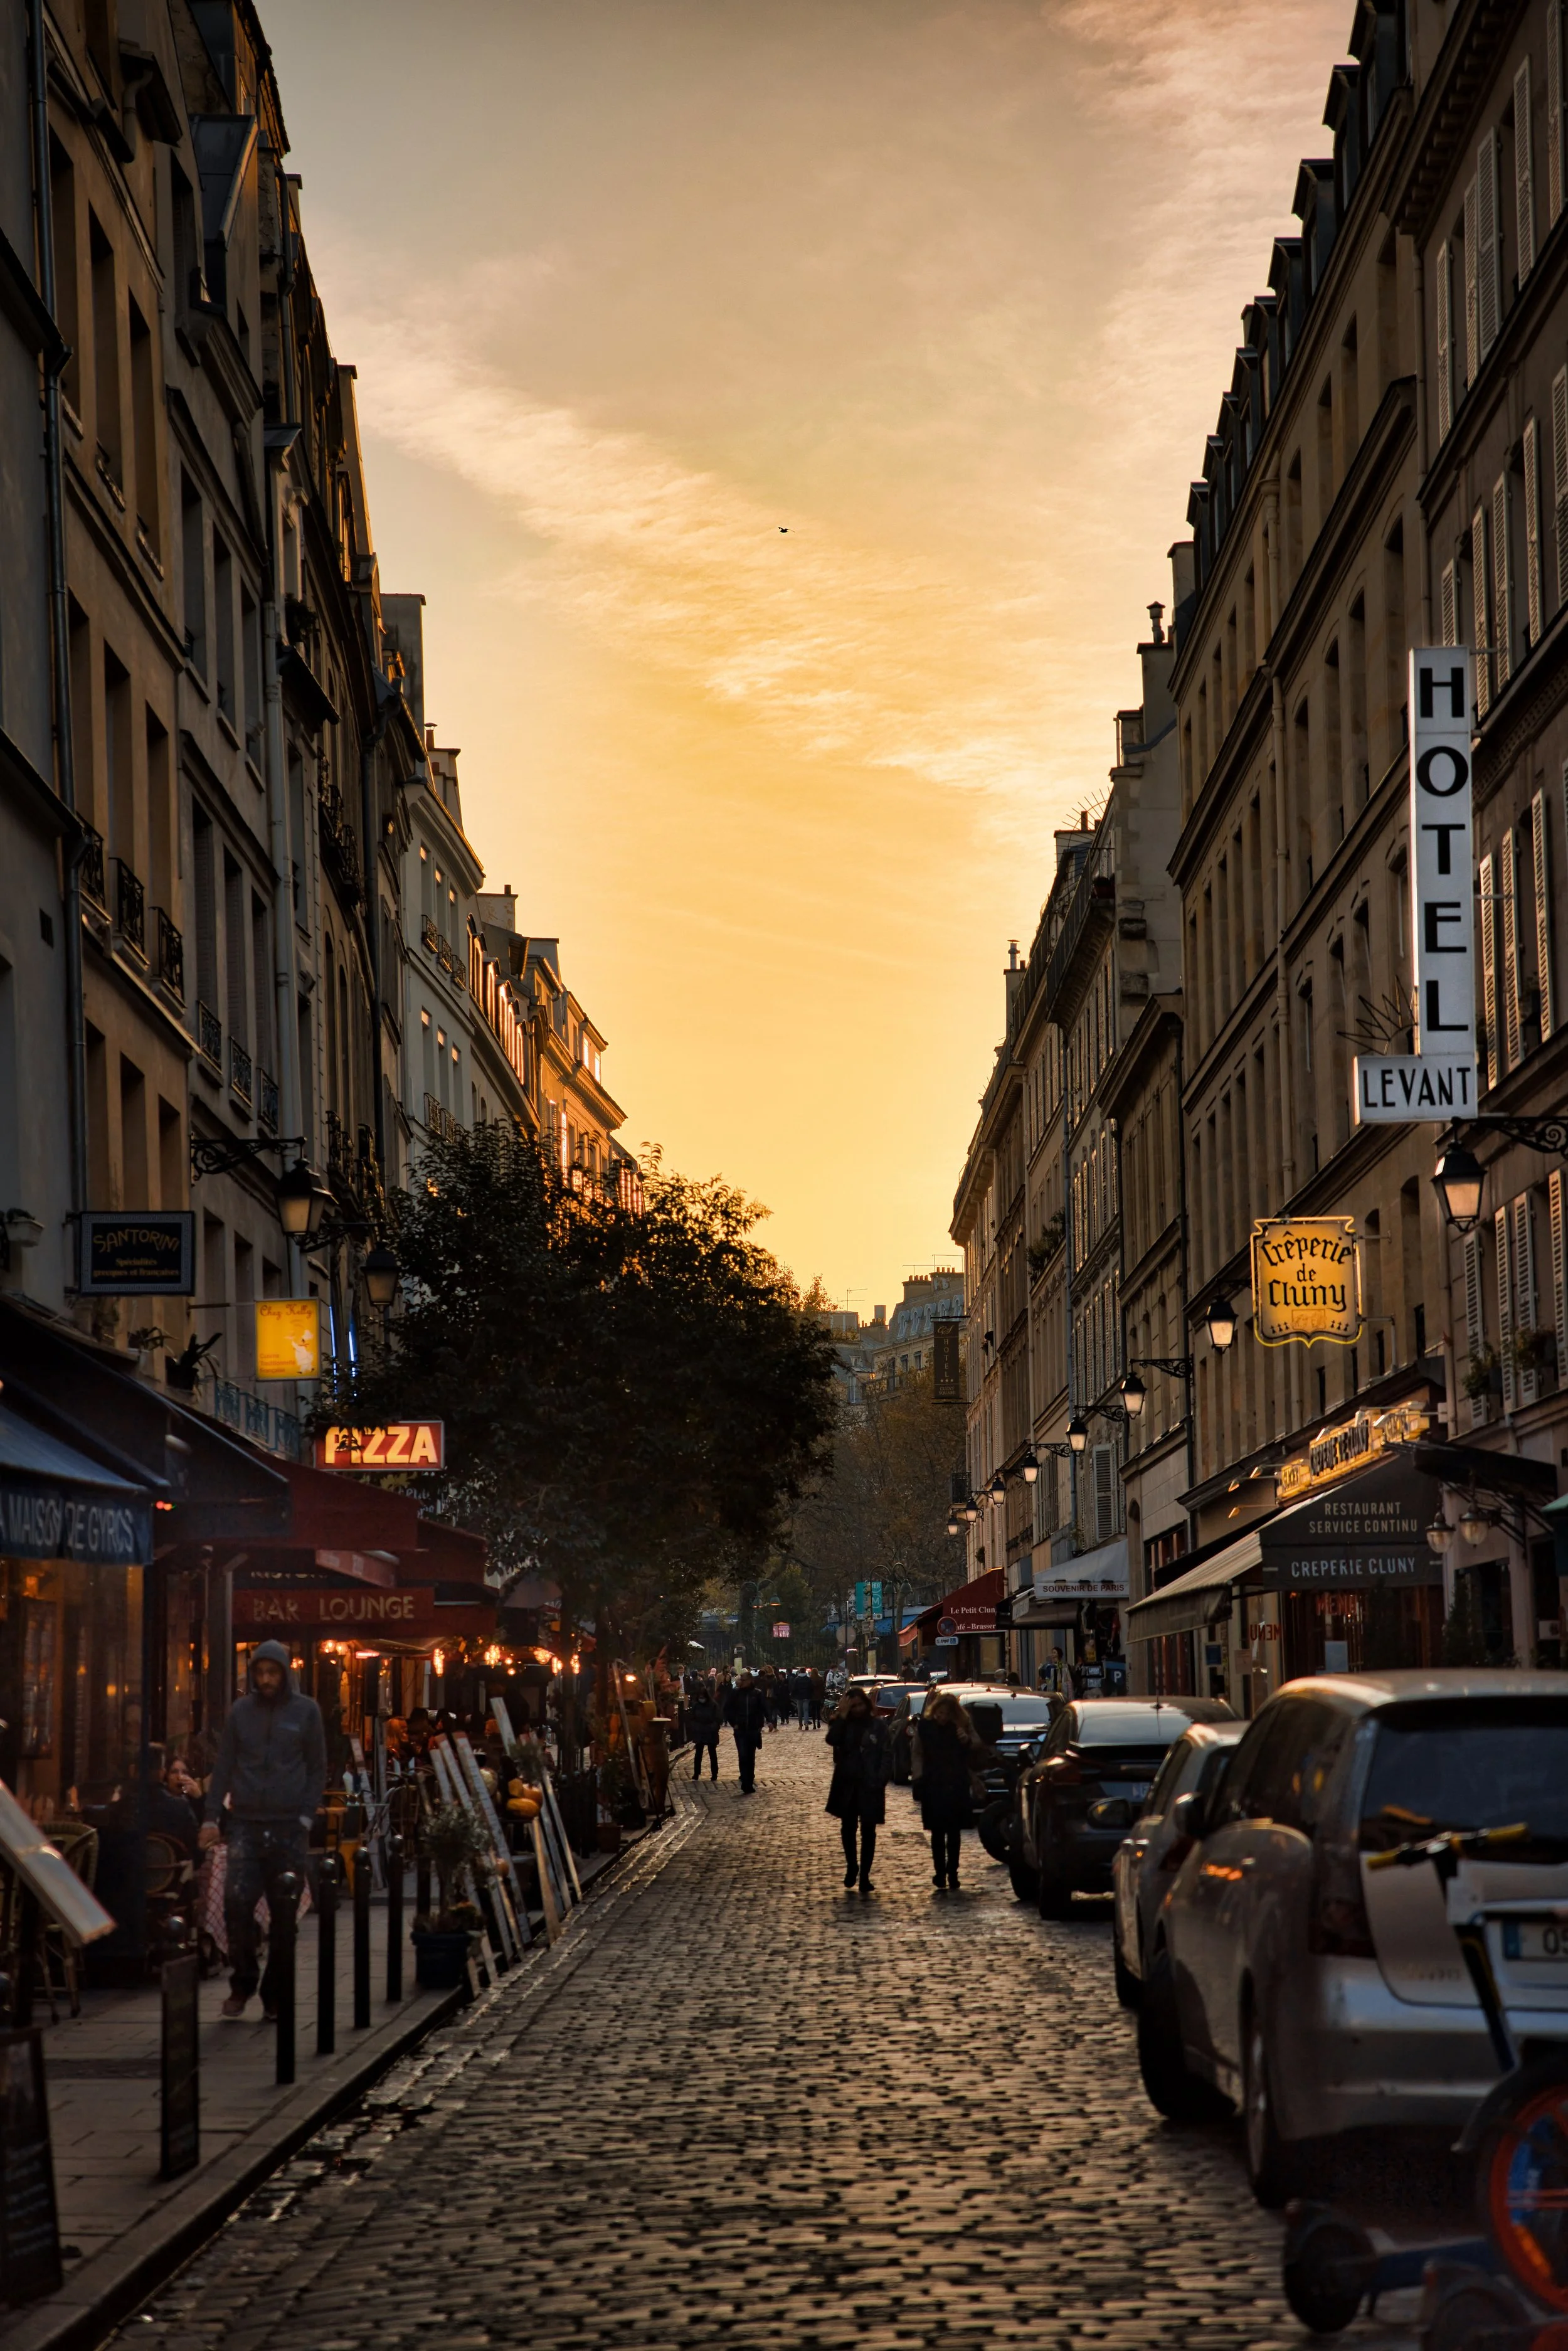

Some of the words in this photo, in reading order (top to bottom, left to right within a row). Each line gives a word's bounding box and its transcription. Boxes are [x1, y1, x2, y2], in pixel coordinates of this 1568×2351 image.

[1416, 667, 1469, 1032] HOTEL
[1363, 1068, 1471, 1108] LEVANT
[93, 1228, 181, 1253] SANTORINI
[1261, 1231, 1352, 1266] Crêperie
[1296, 1263, 1316, 1282] de
[1268, 1278, 1347, 1313] Cluny
[260, 1304, 282, 1320] Chez
[285, 1303, 312, 1319] Kelly
[325, 1426, 438, 1463] PIZZA
[1325, 1502, 1401, 1515] RESTAURANT
[1309, 1520, 1360, 1534] SERVICE
[1364, 1519, 1417, 1533] CONTINU
[1291, 1559, 1363, 1578] CREPERIE
[1368, 1557, 1415, 1575] CLUNY
[253, 1597, 300, 1622] BAR
[319, 1596, 415, 1621] LOUNGE
[1114, 1670, 1122, 1683] P
